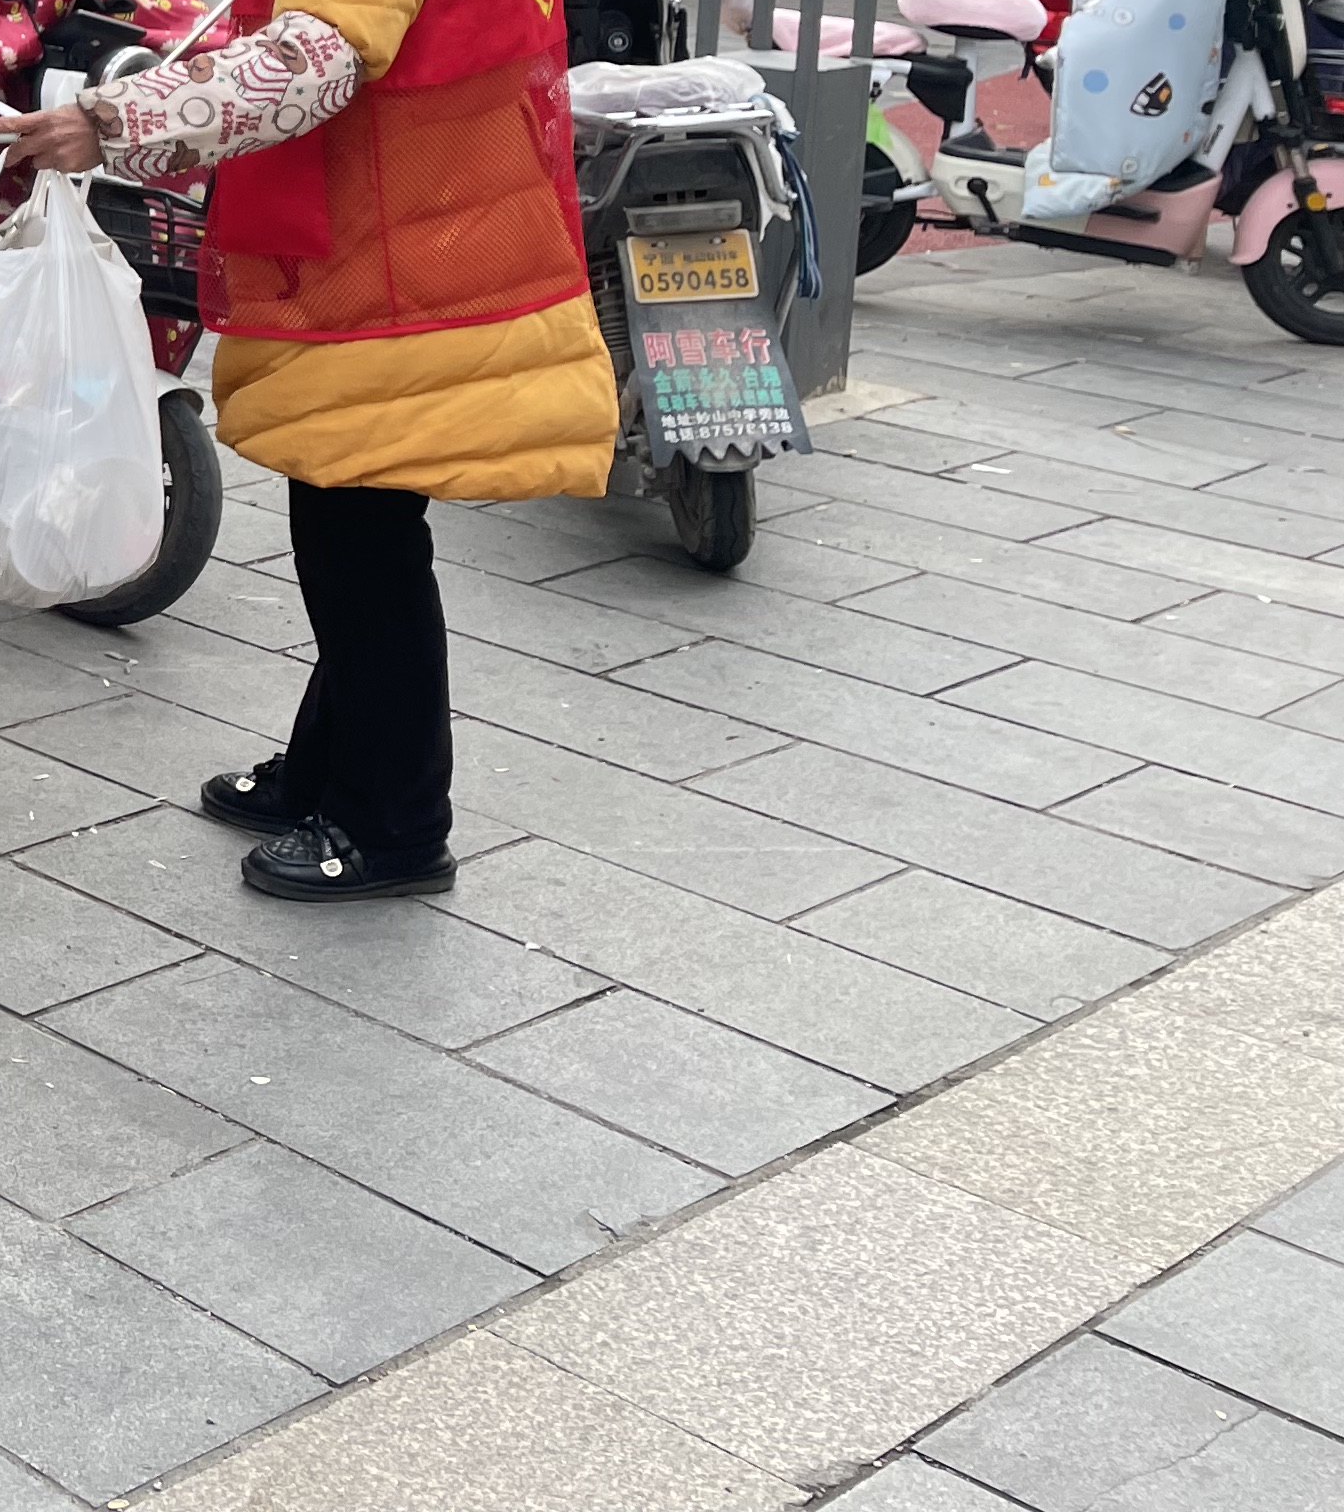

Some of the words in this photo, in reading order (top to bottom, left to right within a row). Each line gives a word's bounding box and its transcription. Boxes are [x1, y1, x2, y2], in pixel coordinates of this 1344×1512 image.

[641, 269, 749, 292] 0590458
[643, 329, 771, 368] 阿雪车行
